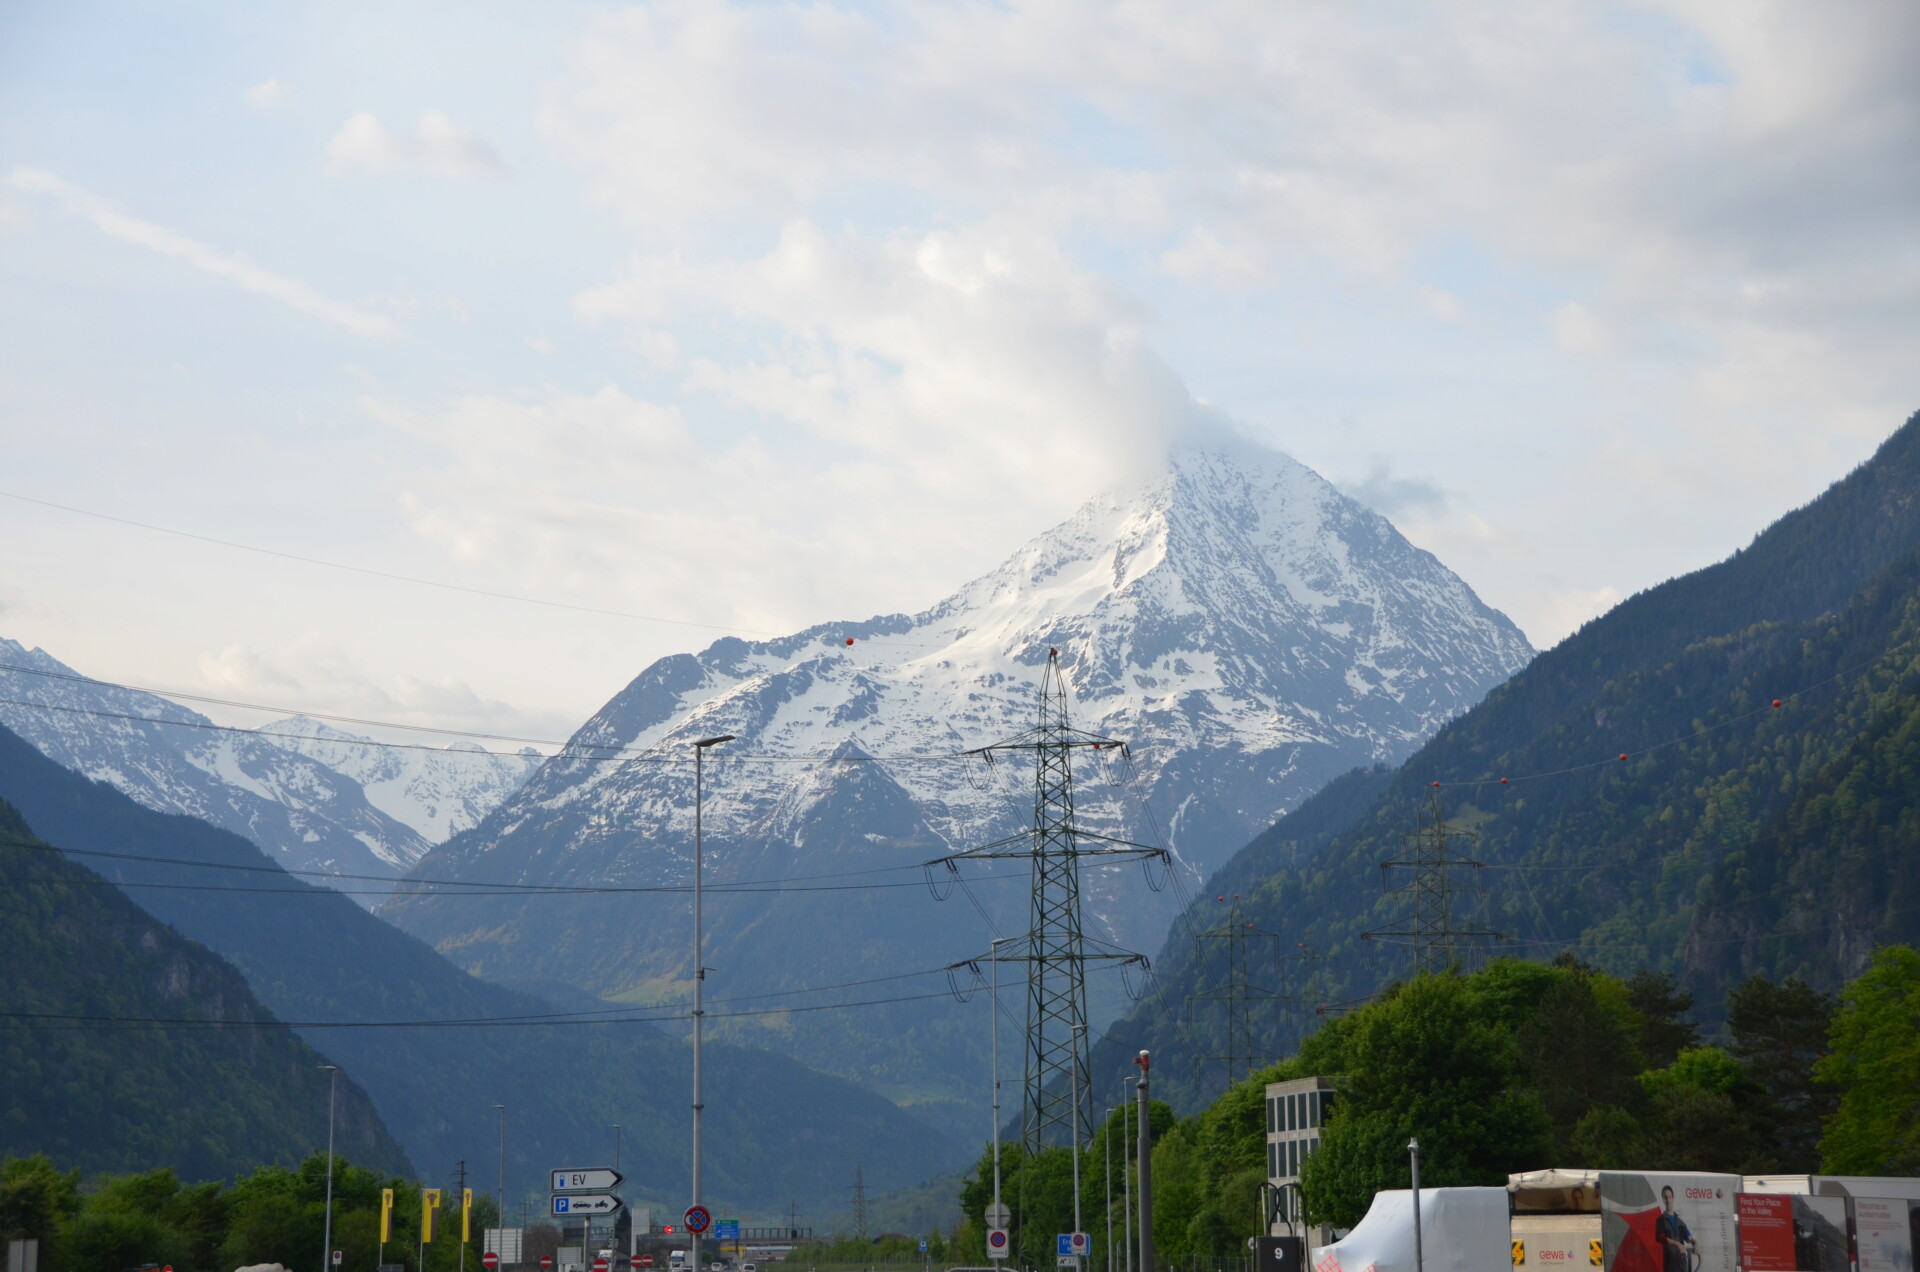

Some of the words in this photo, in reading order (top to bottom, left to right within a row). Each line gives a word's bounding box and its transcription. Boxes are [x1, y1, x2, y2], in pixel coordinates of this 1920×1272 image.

[572, 1173, 586, 1186] EV
[558, 1200, 567, 1211] P
[1740, 1197, 1752, 1205] Find
[1753, 1198, 1765, 1206] Your
[1756, 1208, 1772, 1216] Valley
[1274, 1247, 1283, 1260] 9
